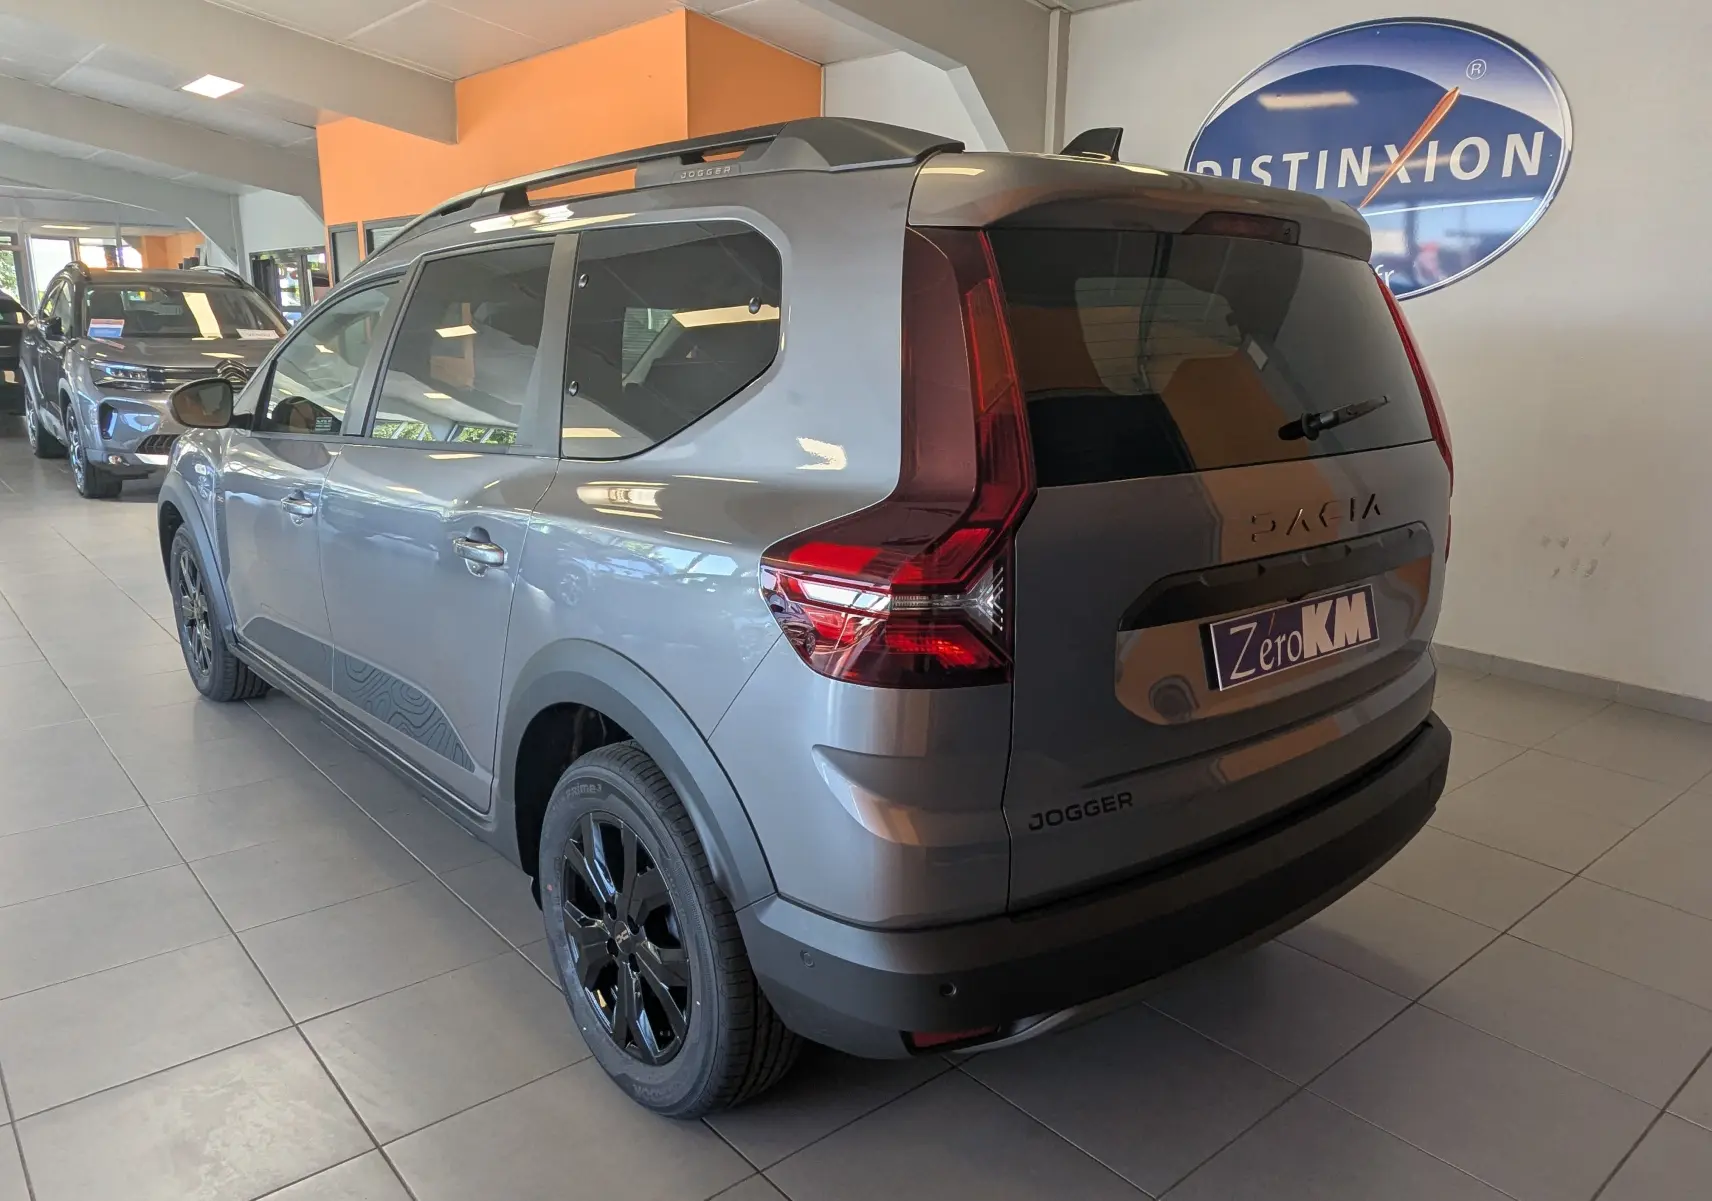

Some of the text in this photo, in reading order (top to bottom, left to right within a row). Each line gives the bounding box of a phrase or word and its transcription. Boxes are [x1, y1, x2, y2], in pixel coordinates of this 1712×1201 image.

[680, 165, 731, 179] JOGGER
[1251, 493, 1381, 542] DACIA
[1028, 791, 1133, 831] JOGGER
